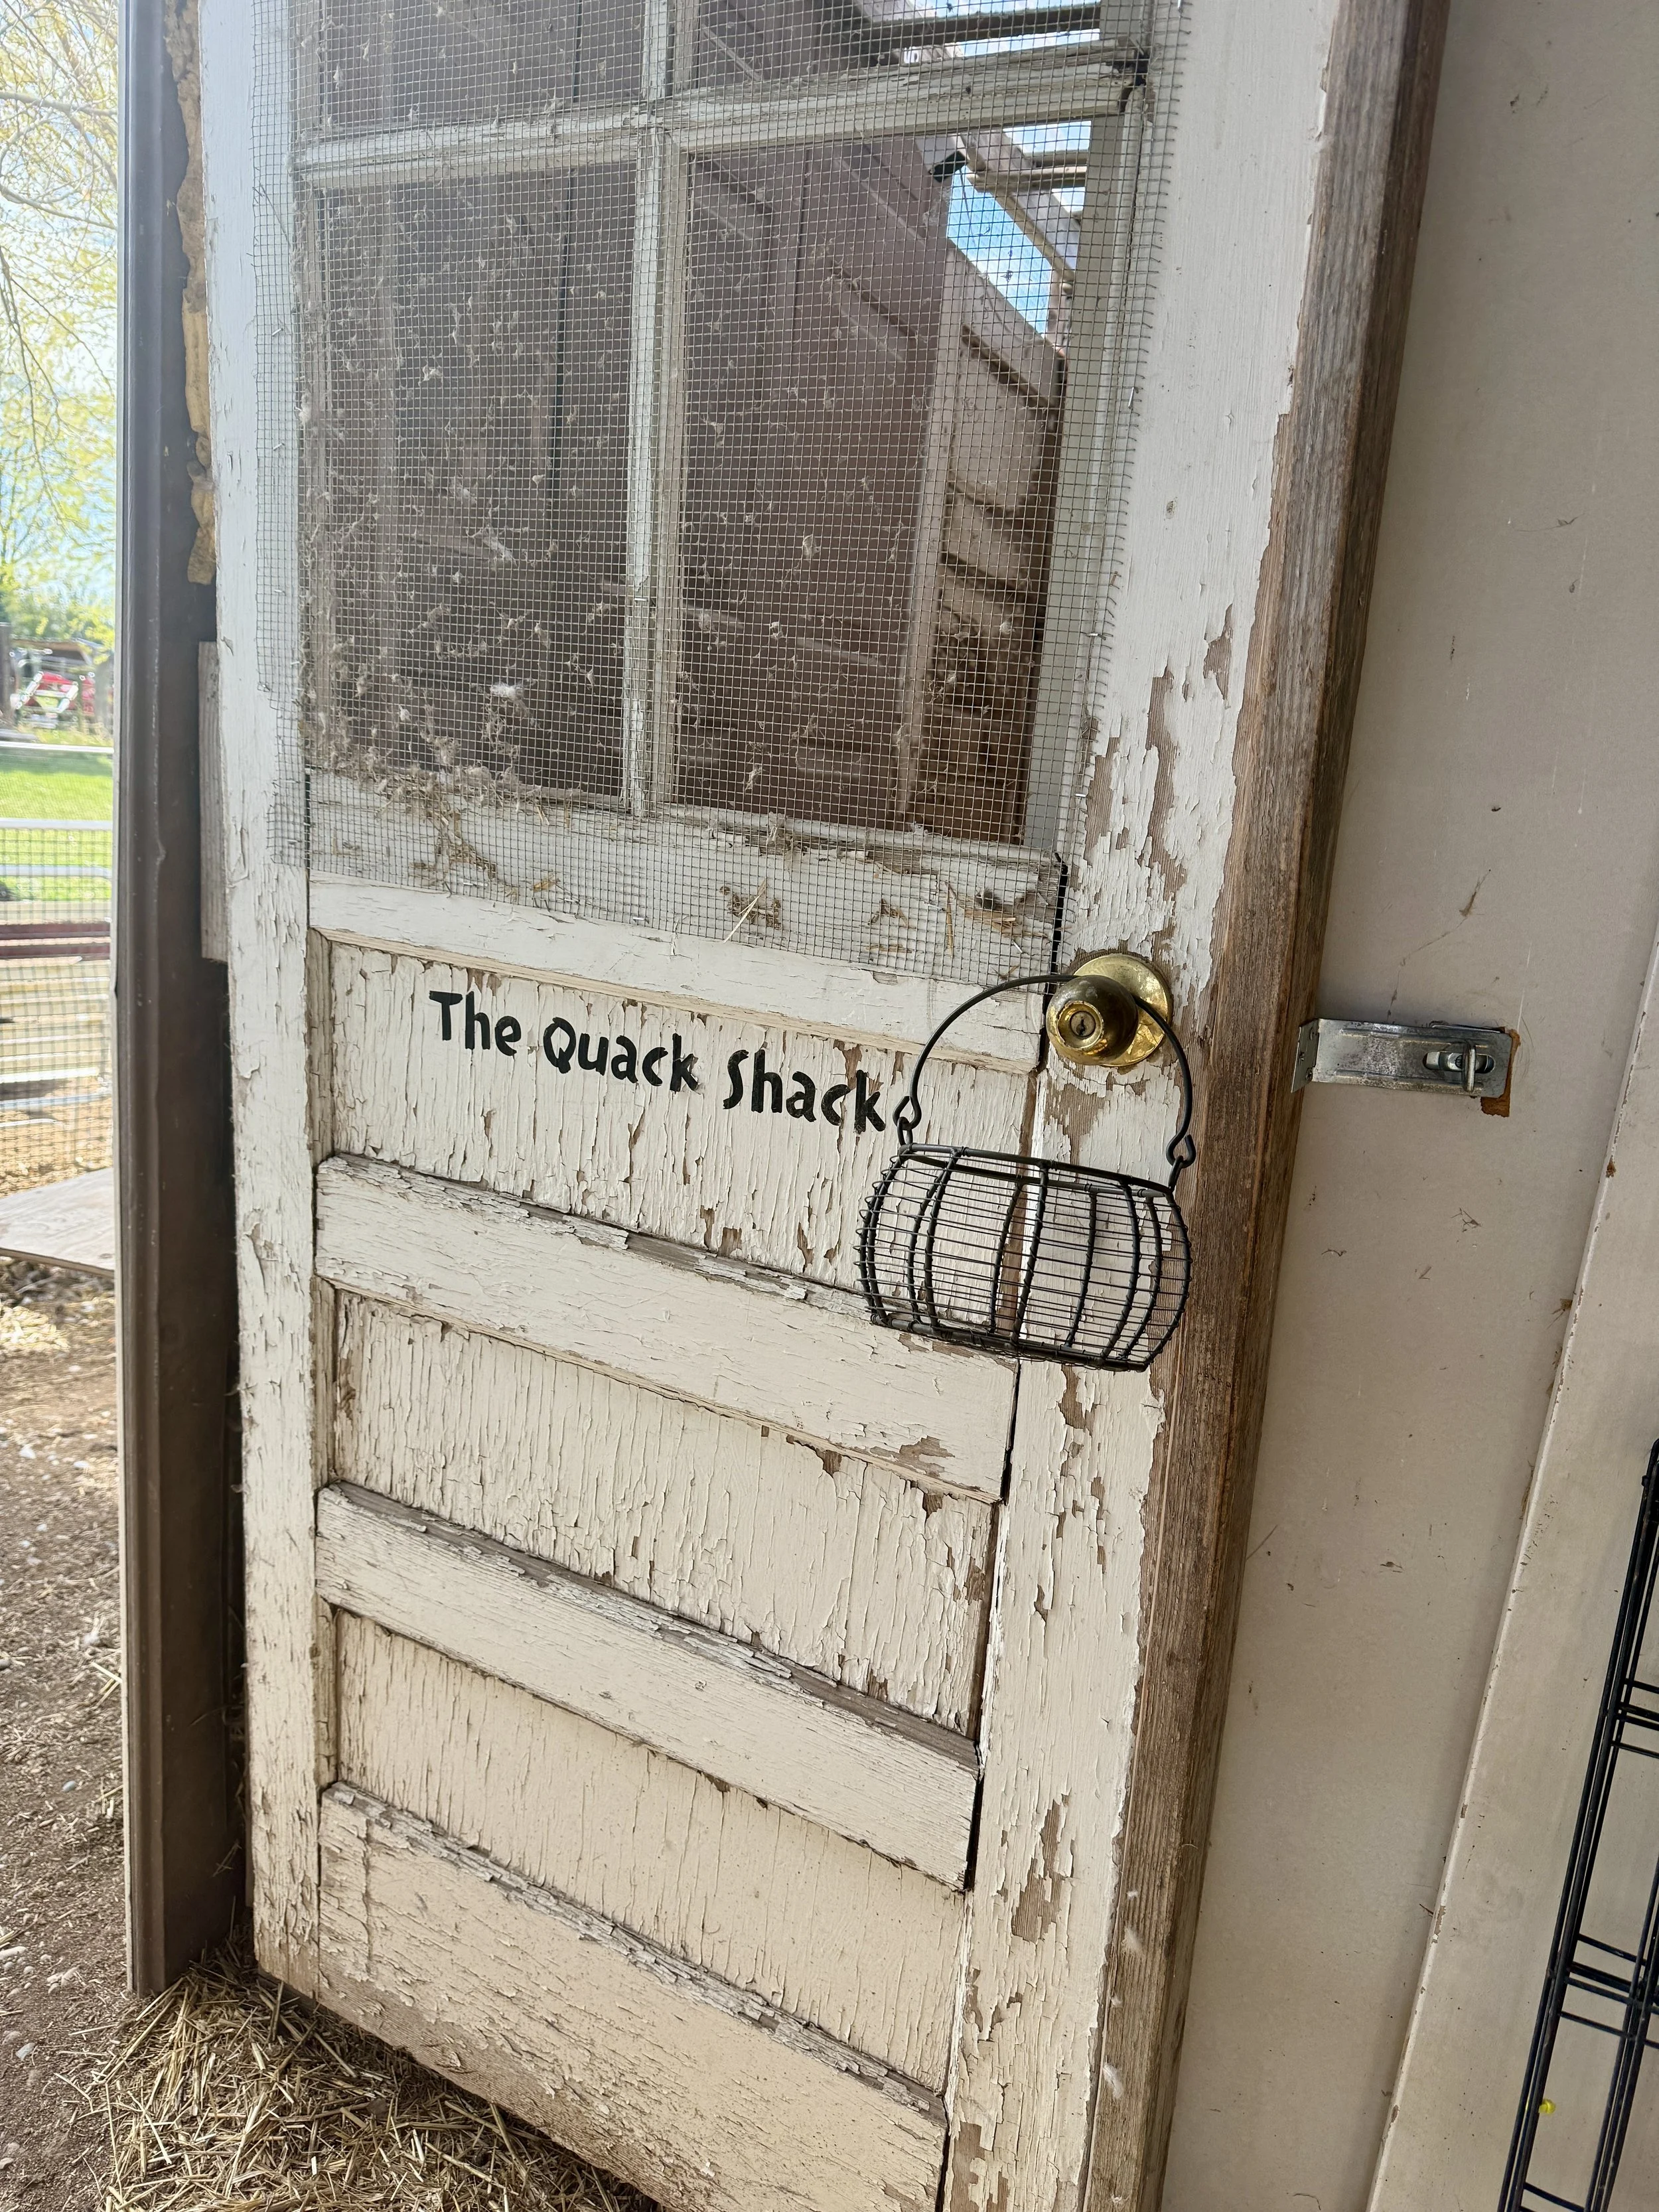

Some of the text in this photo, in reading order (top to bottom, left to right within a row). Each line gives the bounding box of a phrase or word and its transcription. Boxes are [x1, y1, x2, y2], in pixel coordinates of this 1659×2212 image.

[429, 991, 886, 1134] The Quack Shack
